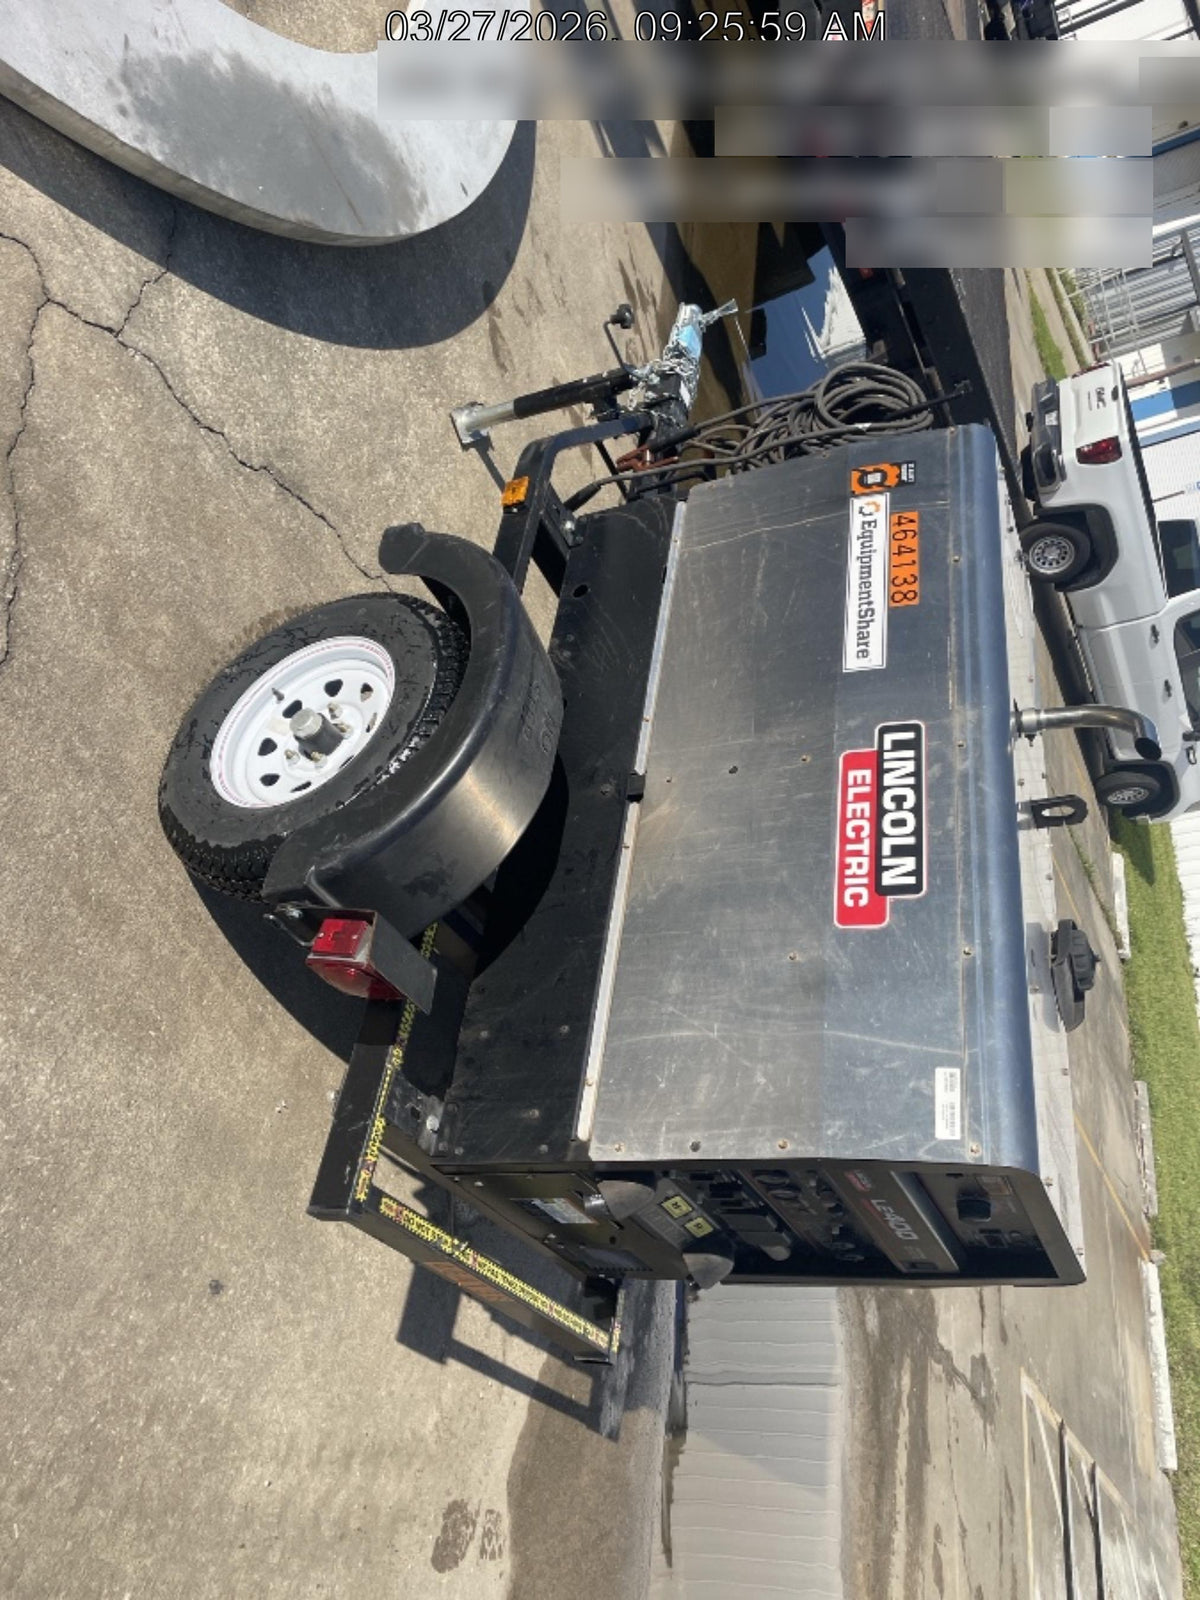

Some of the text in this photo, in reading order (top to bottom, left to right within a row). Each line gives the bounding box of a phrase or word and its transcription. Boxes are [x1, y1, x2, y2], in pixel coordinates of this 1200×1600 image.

[854, 519, 878, 660] EquipmentShare
[889, 514, 918, 604] 464138
[842, 768, 871, 907] ELECTRIC
[880, 731, 916, 886] LINCOLN
